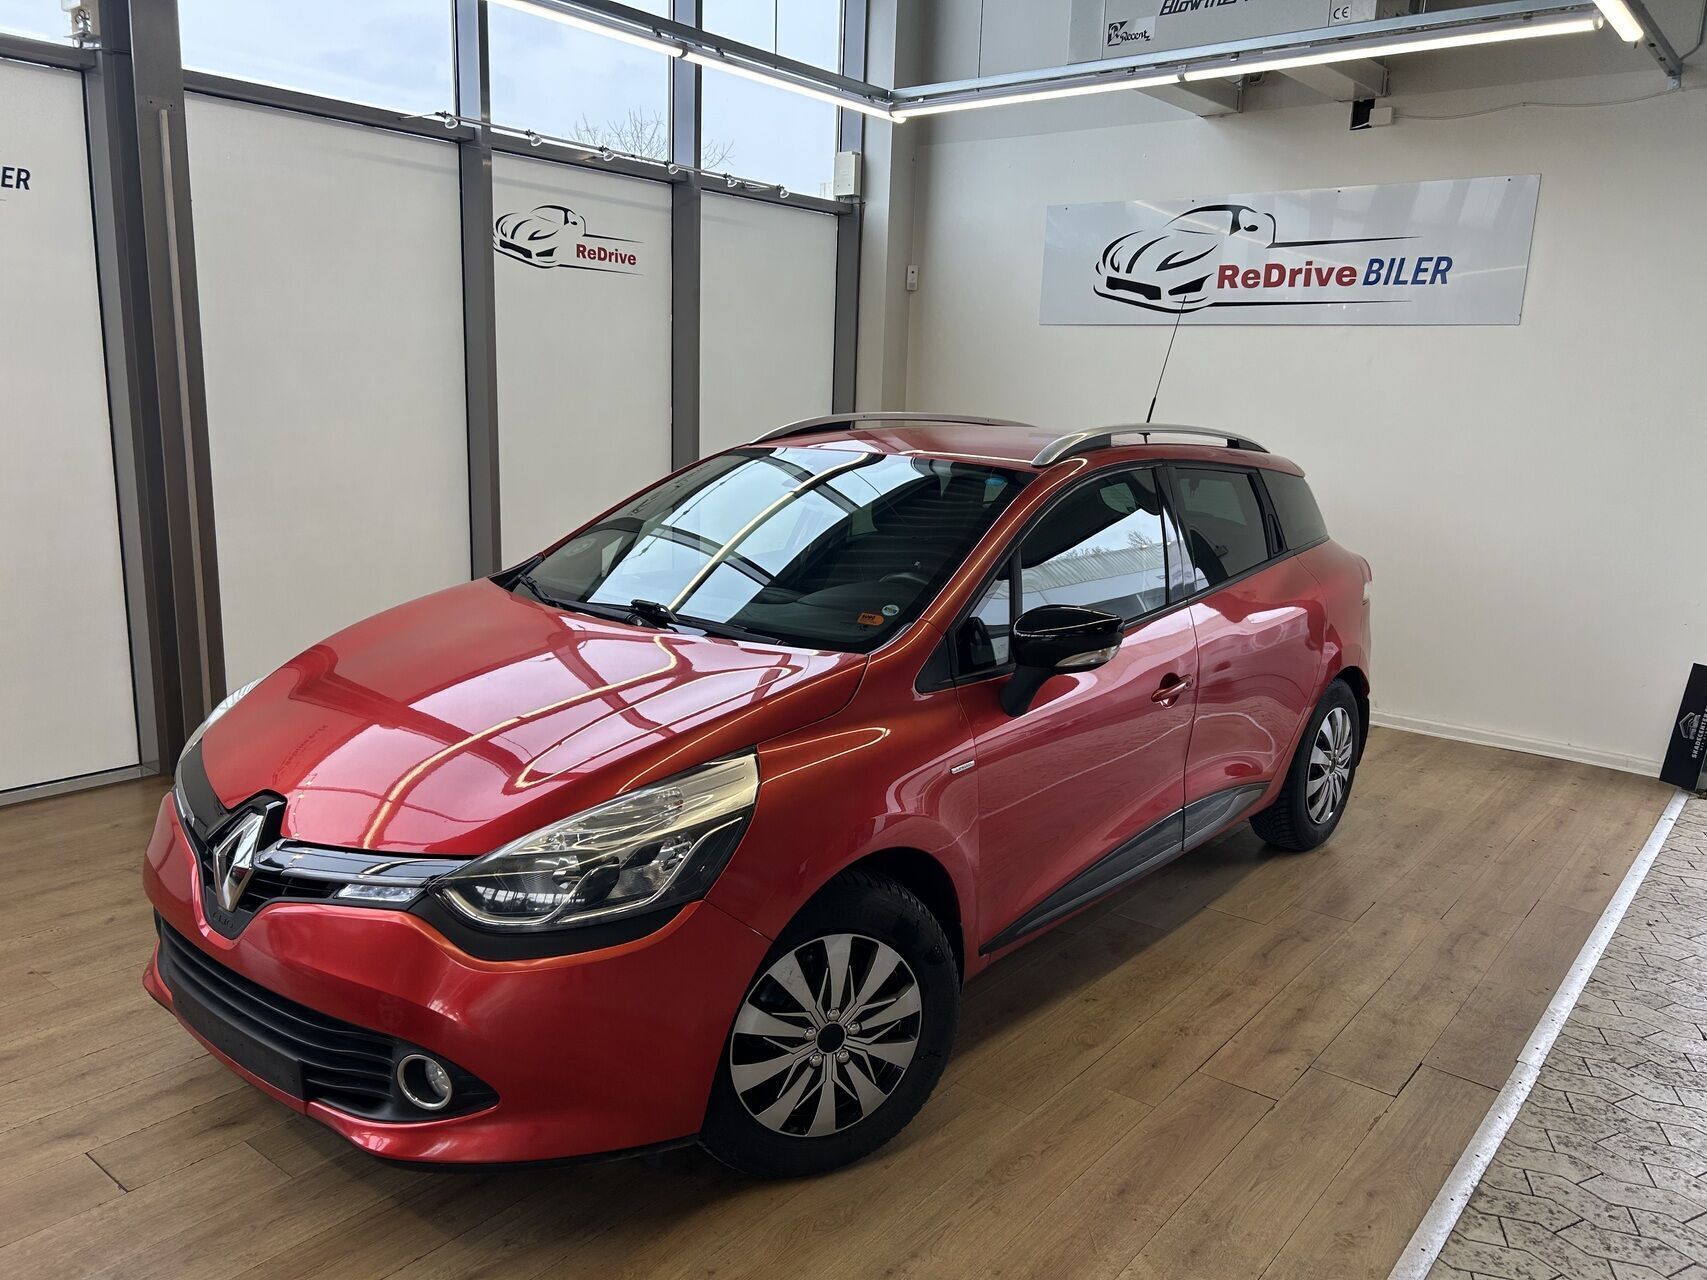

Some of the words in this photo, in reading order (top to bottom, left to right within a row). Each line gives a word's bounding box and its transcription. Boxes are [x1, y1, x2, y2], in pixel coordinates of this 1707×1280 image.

[1333, 6, 1349, 20] CE
[576, 243, 637, 265] ReDrive
[1217, 260, 1358, 289] ReDrive
[1362, 256, 1453, 286] BILER
